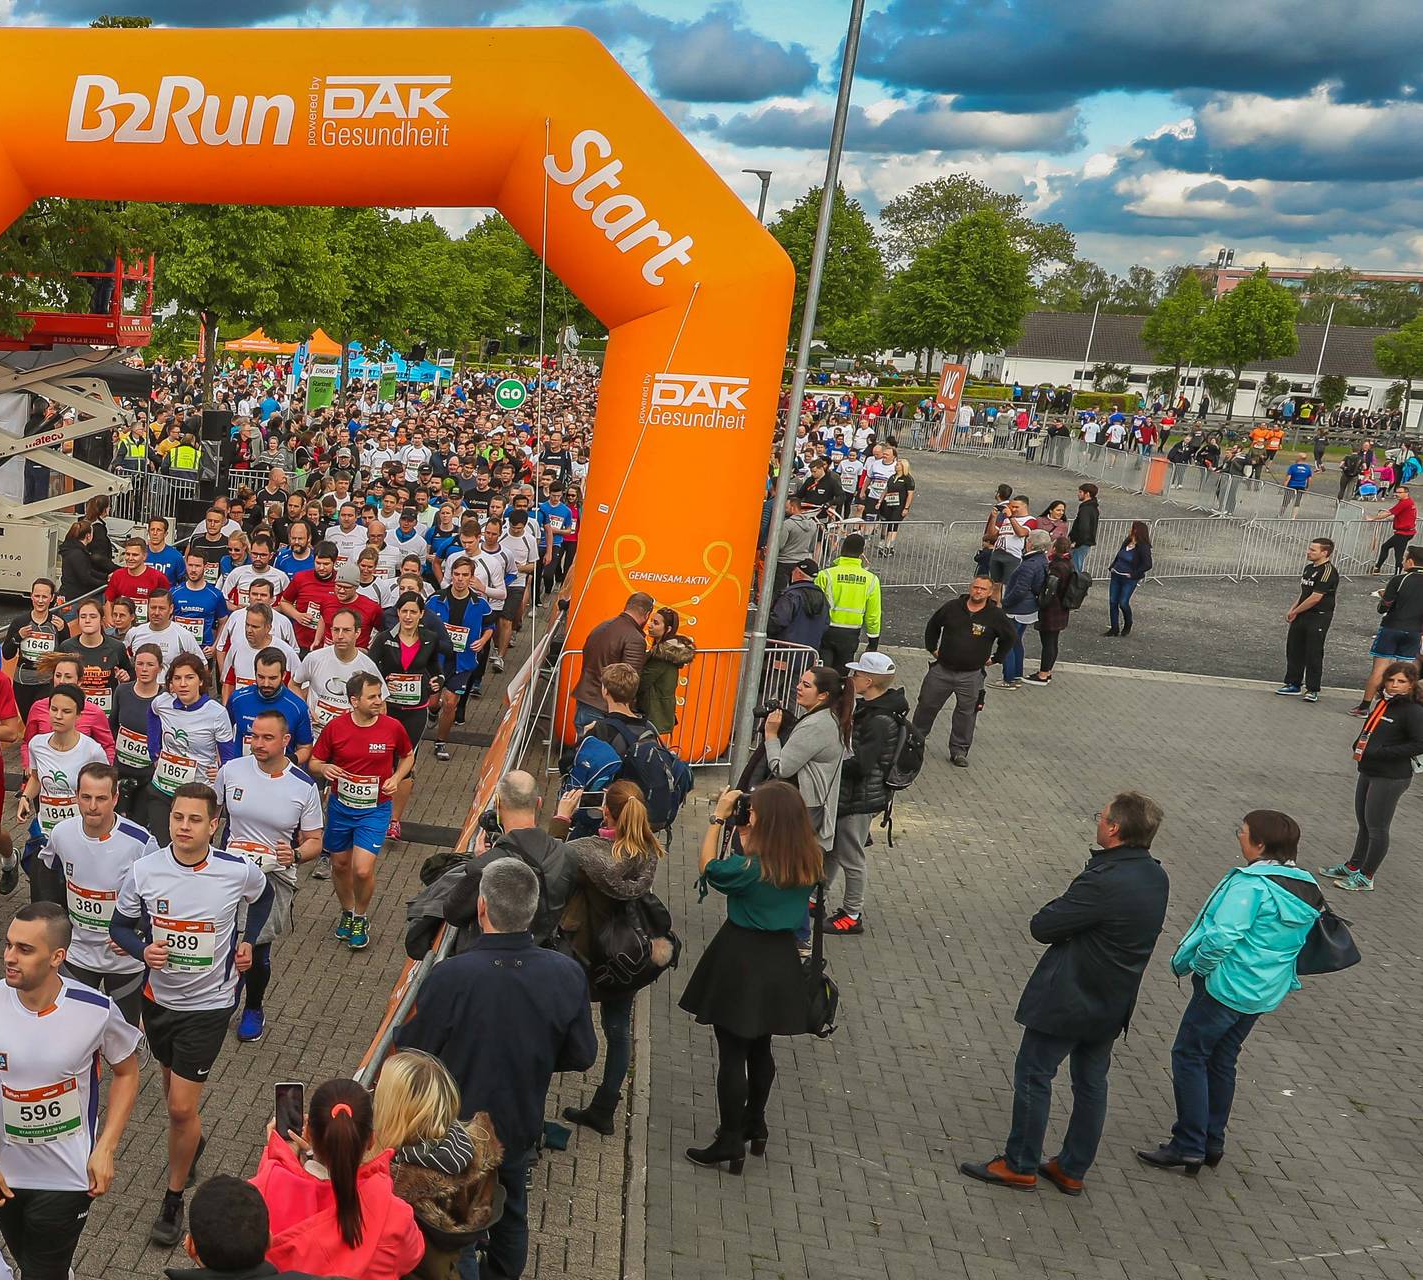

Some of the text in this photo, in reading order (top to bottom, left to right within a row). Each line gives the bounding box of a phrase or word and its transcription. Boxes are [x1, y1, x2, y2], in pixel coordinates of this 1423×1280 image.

[322, 75, 454, 119] DAK
[66, 75, 297, 146] B2Run
[308, 76, 322, 147] powered by
[321, 120, 450, 147] Gesundheit
[543, 129, 694, 286] Start
[499, 387, 522, 400] GO
[651, 373, 750, 410] DAK
[941, 369, 960, 400] WC
[648, 406, 746, 430] Gesundheit
[685, 576, 711, 585] AKTIV
[26, 639, 50, 650] 1646
[122, 738, 148, 755] 1648
[162, 763, 189, 779] 1867
[343, 781, 372, 796] 2885
[45, 807, 75, 819] 1844
[75, 898, 102, 915] 380
[166, 933, 199, 951] 589
[20, 1101, 62, 1122] 596
